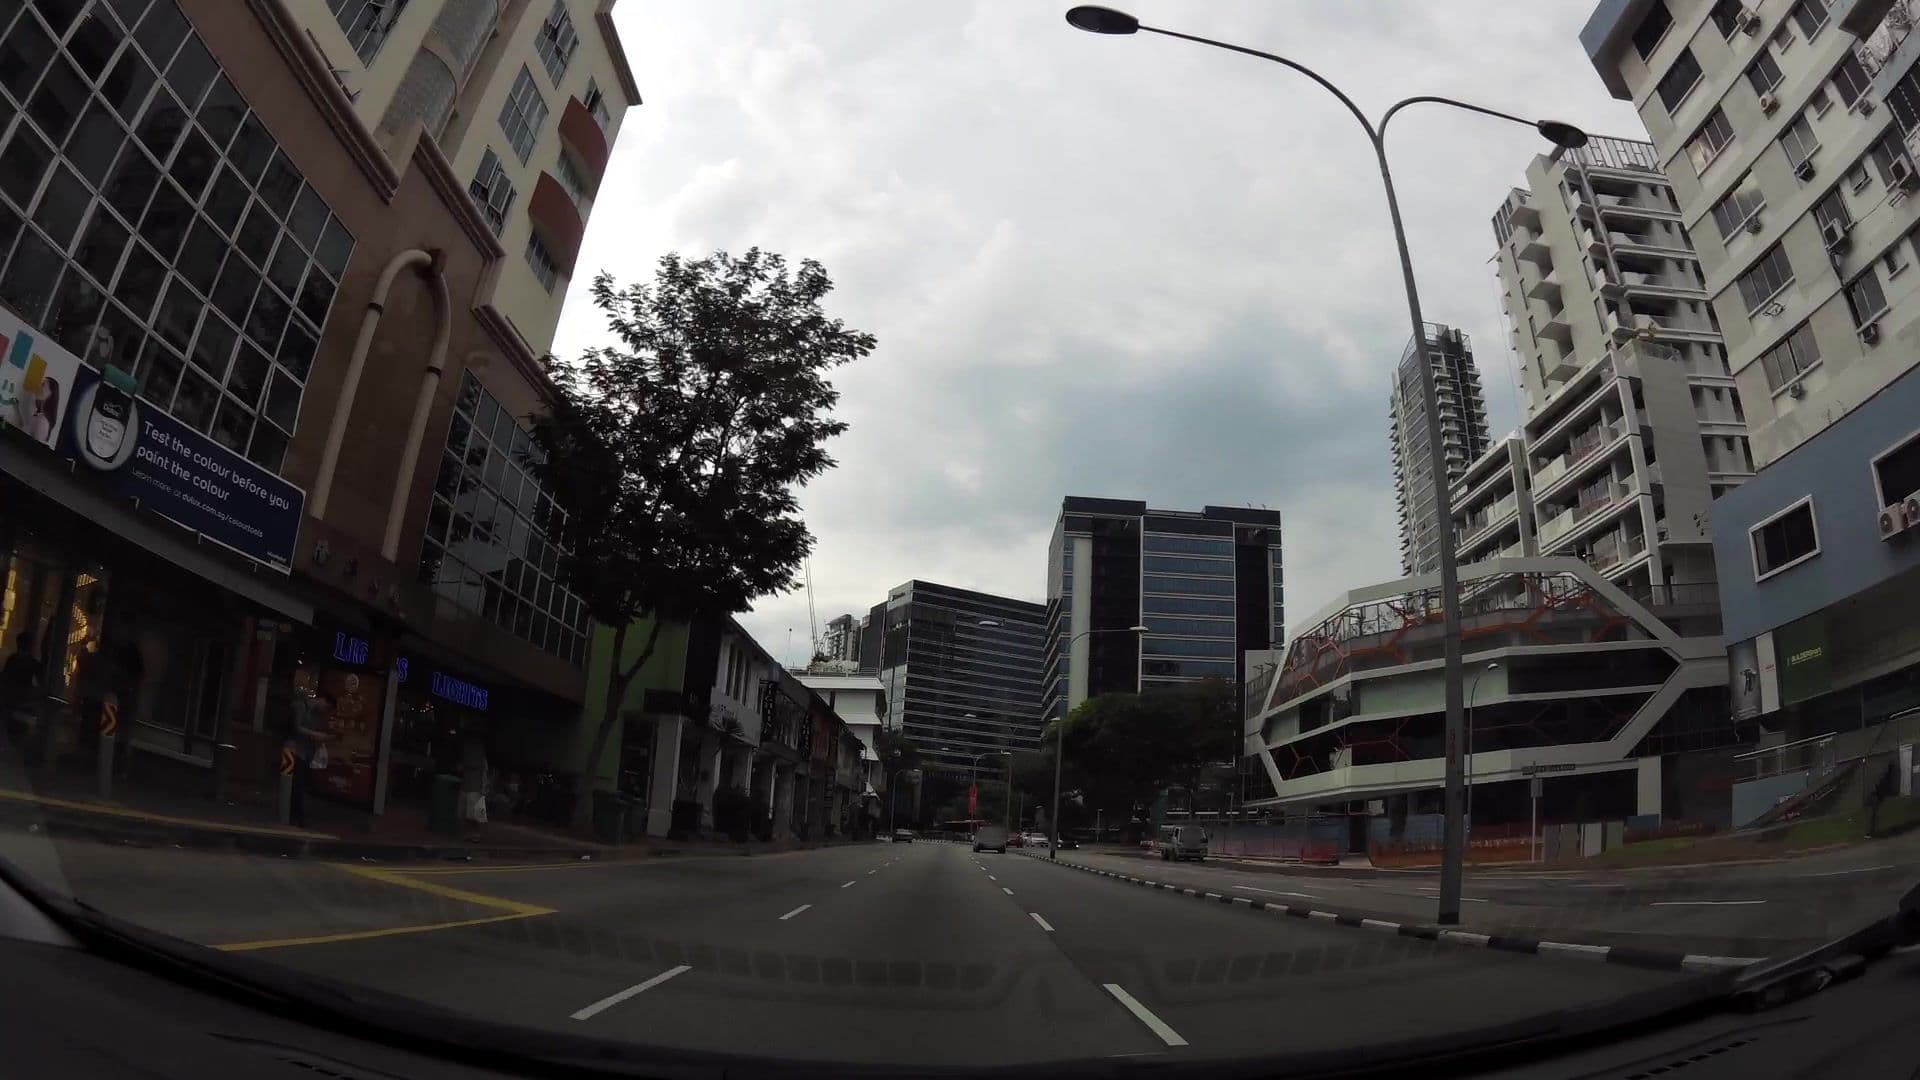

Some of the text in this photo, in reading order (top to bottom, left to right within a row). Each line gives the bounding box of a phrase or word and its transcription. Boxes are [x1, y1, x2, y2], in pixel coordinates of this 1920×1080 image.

[132, 467, 154, 483] Learn
[153, 479, 172, 494] more
[136, 445, 230, 501] paint the colour
[144, 420, 170, 446] Test
[172, 436, 192, 458] the
[193, 452, 230, 480] colour
[232, 470, 267, 499] before
[269, 494, 290, 511] you
